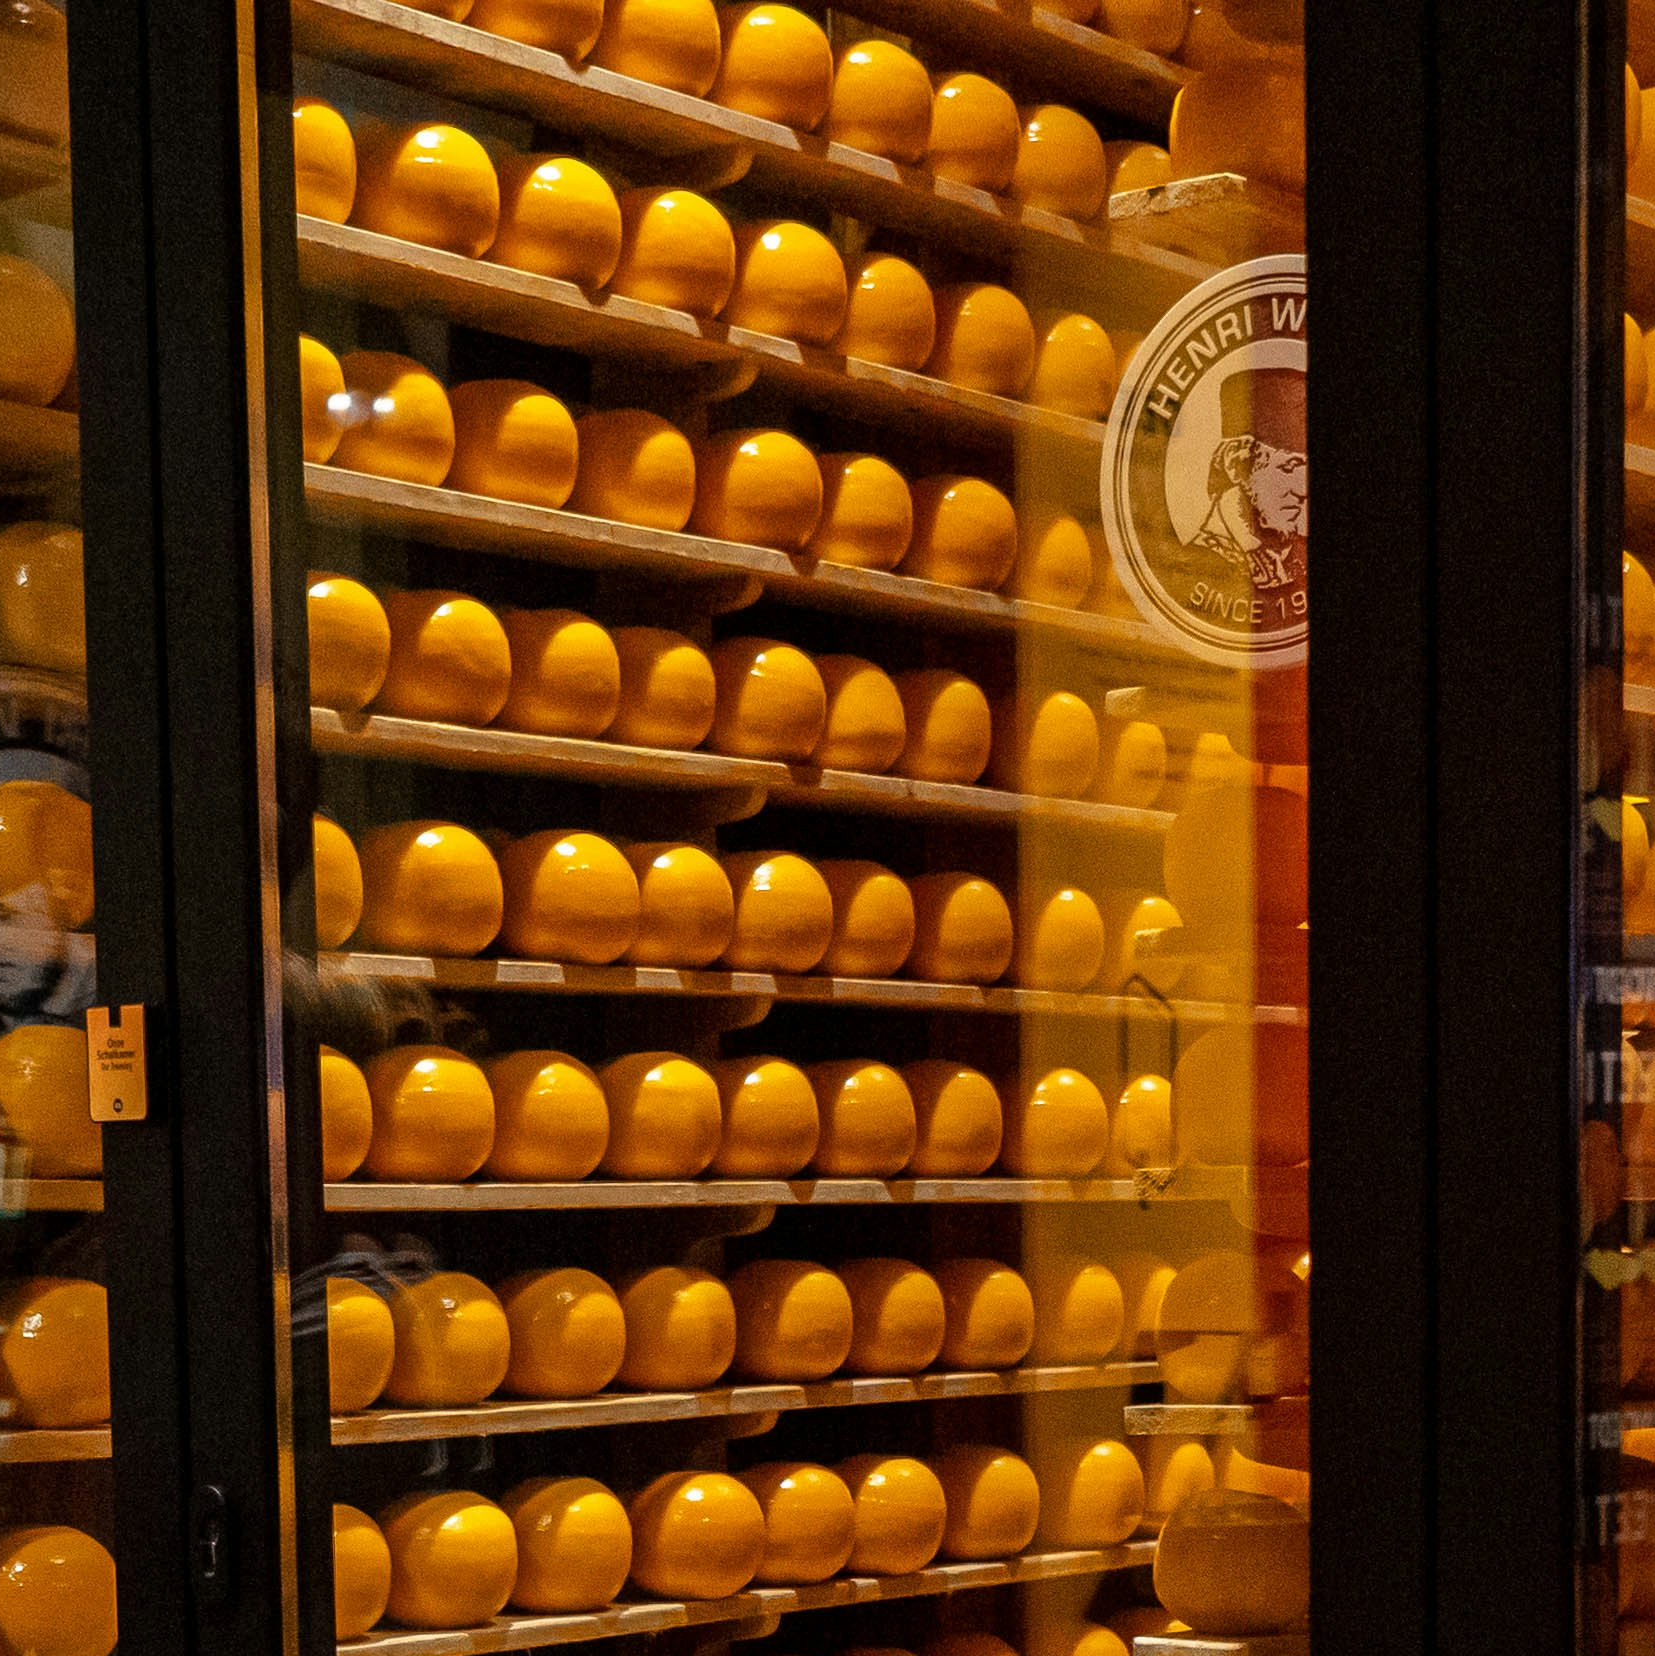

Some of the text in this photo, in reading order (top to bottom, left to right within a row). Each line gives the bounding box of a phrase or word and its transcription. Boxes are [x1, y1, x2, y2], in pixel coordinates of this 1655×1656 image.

[1147, 297, 1307, 421] HENRI W
[1188, 580, 1308, 624] SINCE 19
